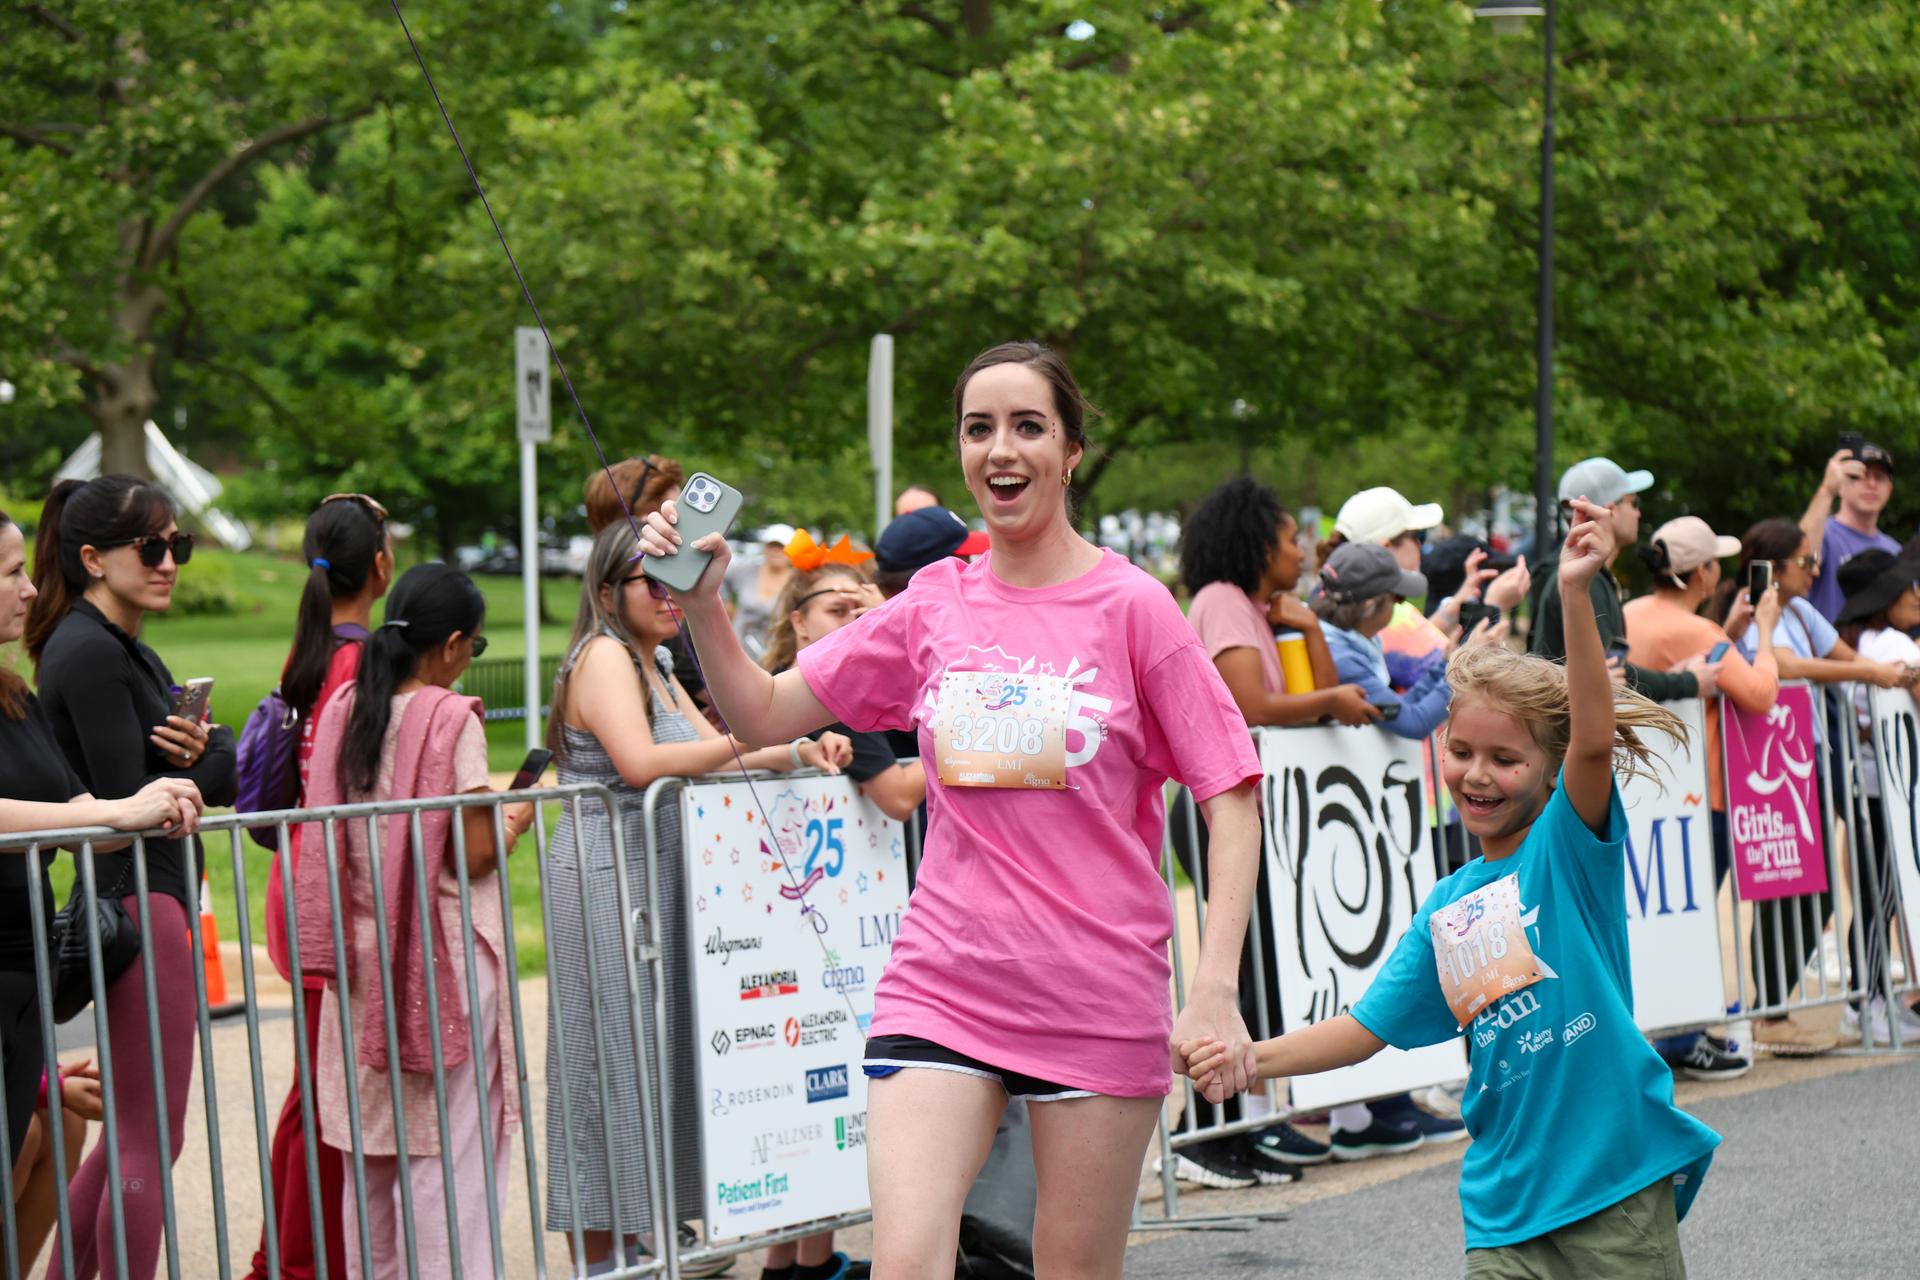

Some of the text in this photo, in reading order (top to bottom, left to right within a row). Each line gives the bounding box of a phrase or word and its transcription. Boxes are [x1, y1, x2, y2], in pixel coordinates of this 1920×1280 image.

[1000, 684, 1028, 706] 25
[951, 714, 1044, 756] 3208
[1733, 803, 1785, 845] Girls
[804, 818, 845, 879] 25
[1762, 838, 1801, 870] run
[1466, 898, 1485, 926] 25
[703, 925, 762, 967] Wegmans
[1445, 921, 1508, 989] 1018
[740, 969, 799, 990] ALEXANDRIA
[822, 965, 865, 994] cigna
[736, 1024, 776, 1043] EPNAC
[801, 1010, 848, 1028] ALEXANDRIA
[1476, 1028, 1497, 1049] the
[1491, 989, 1541, 1029] un
[801, 1027, 838, 1046] ELECTRIC
[728, 1083, 794, 1106] ROSENDIN
[807, 1069, 848, 1092] CLARK
[717, 1172, 789, 1206] Patient First
